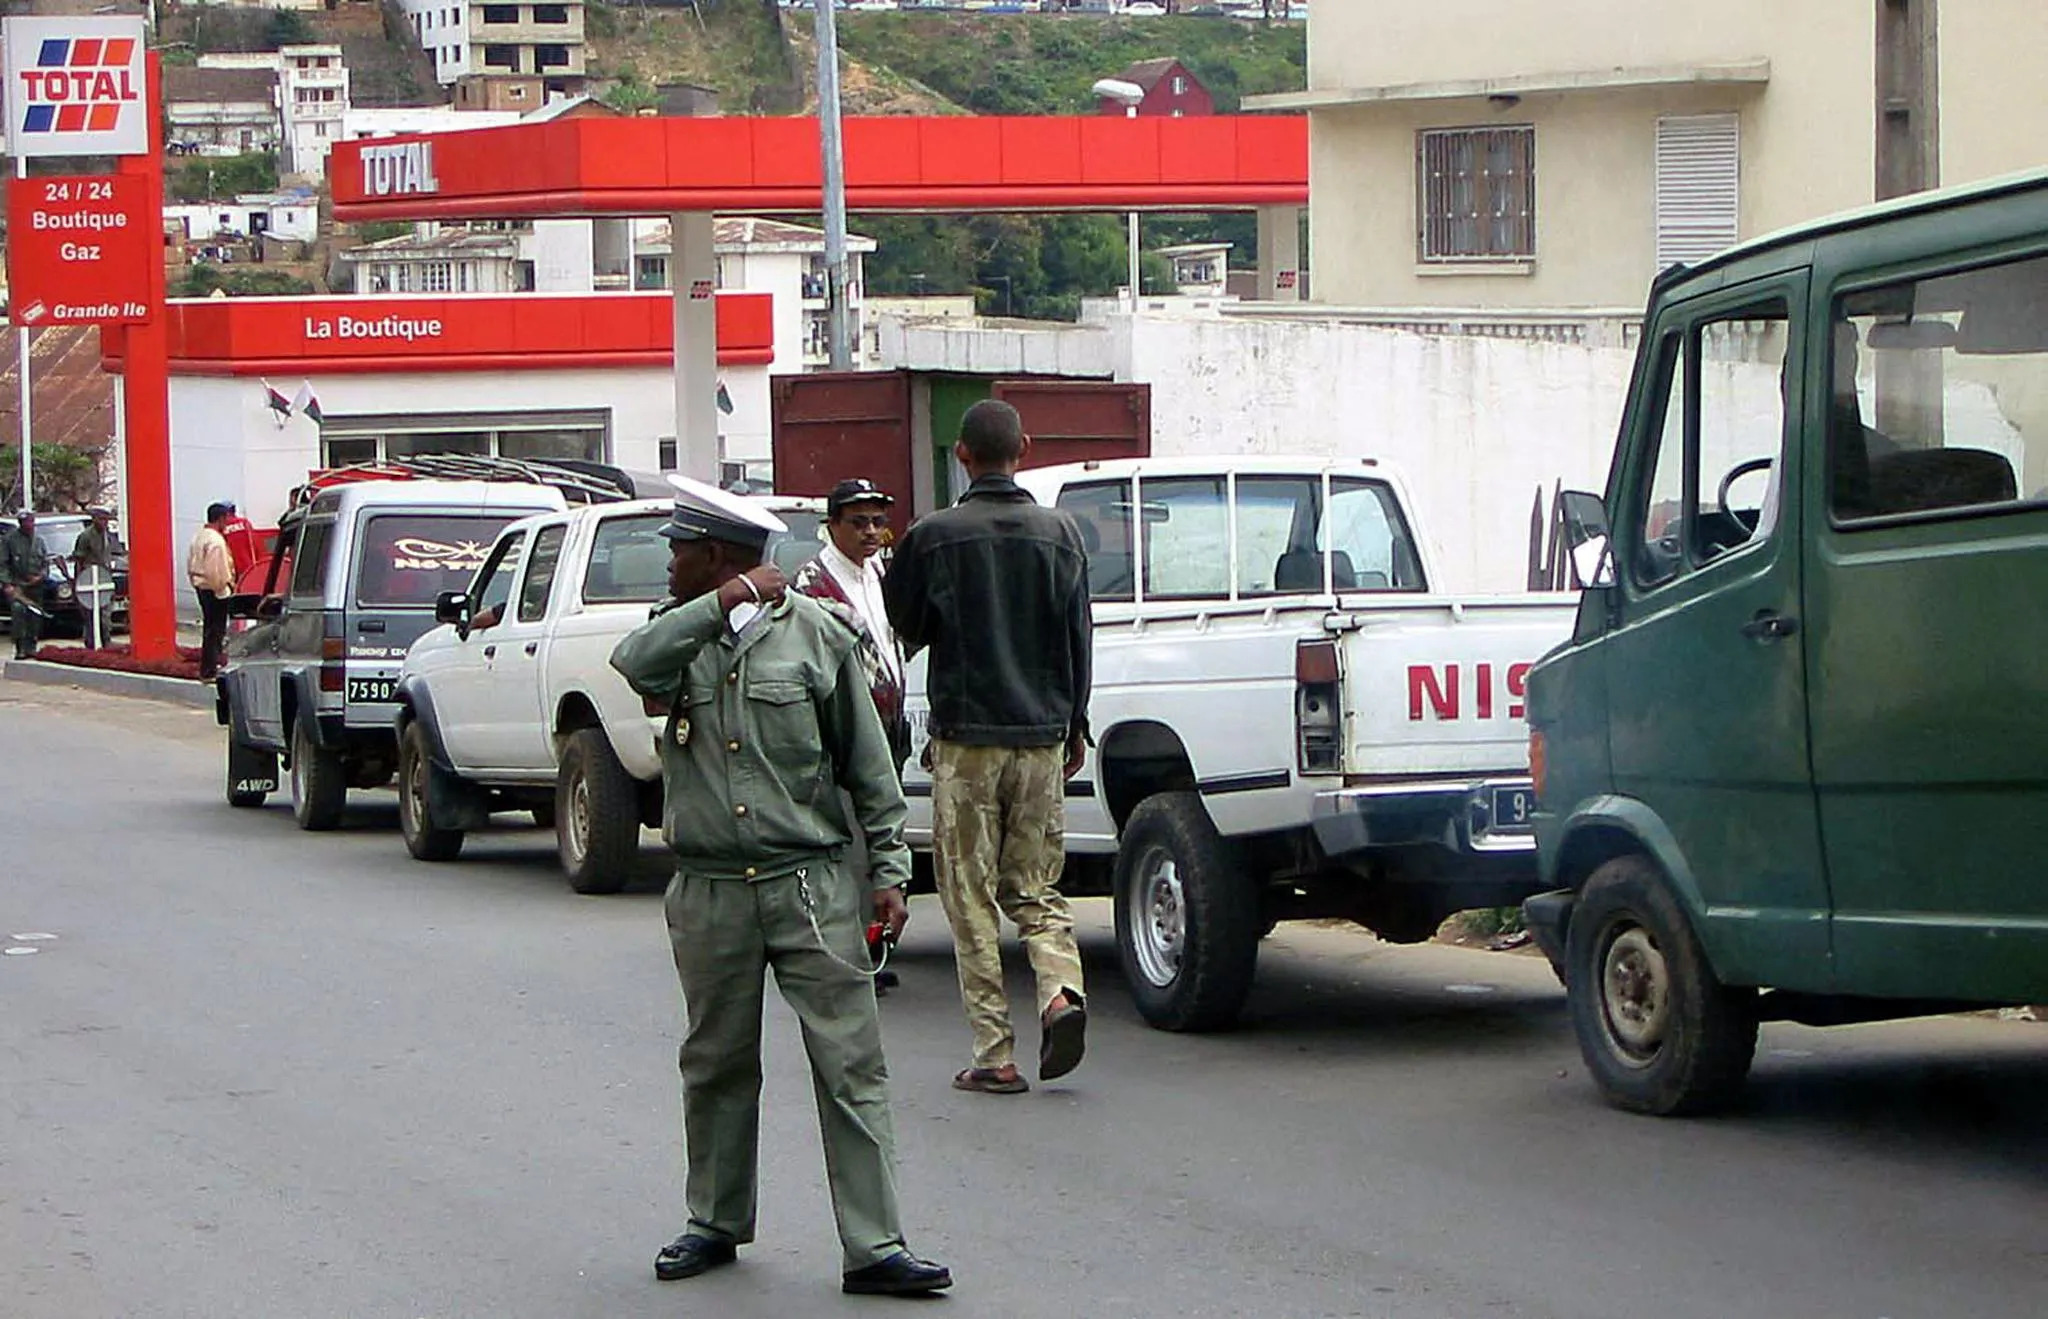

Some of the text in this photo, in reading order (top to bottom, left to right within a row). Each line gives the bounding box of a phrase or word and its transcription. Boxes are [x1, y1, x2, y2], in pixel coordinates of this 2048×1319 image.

[20, 70, 138, 101] TOTAL
[360, 141, 439, 195] TOTAL
[45, 183, 70, 201] 24
[89, 182, 113, 200] 24
[32, 210, 127, 231] Boutique
[60, 242, 101, 260] Gaz
[53, 303, 119, 318] Grande
[305, 315, 442, 342] La Boutique
[237, 778, 275, 792] 4WD
